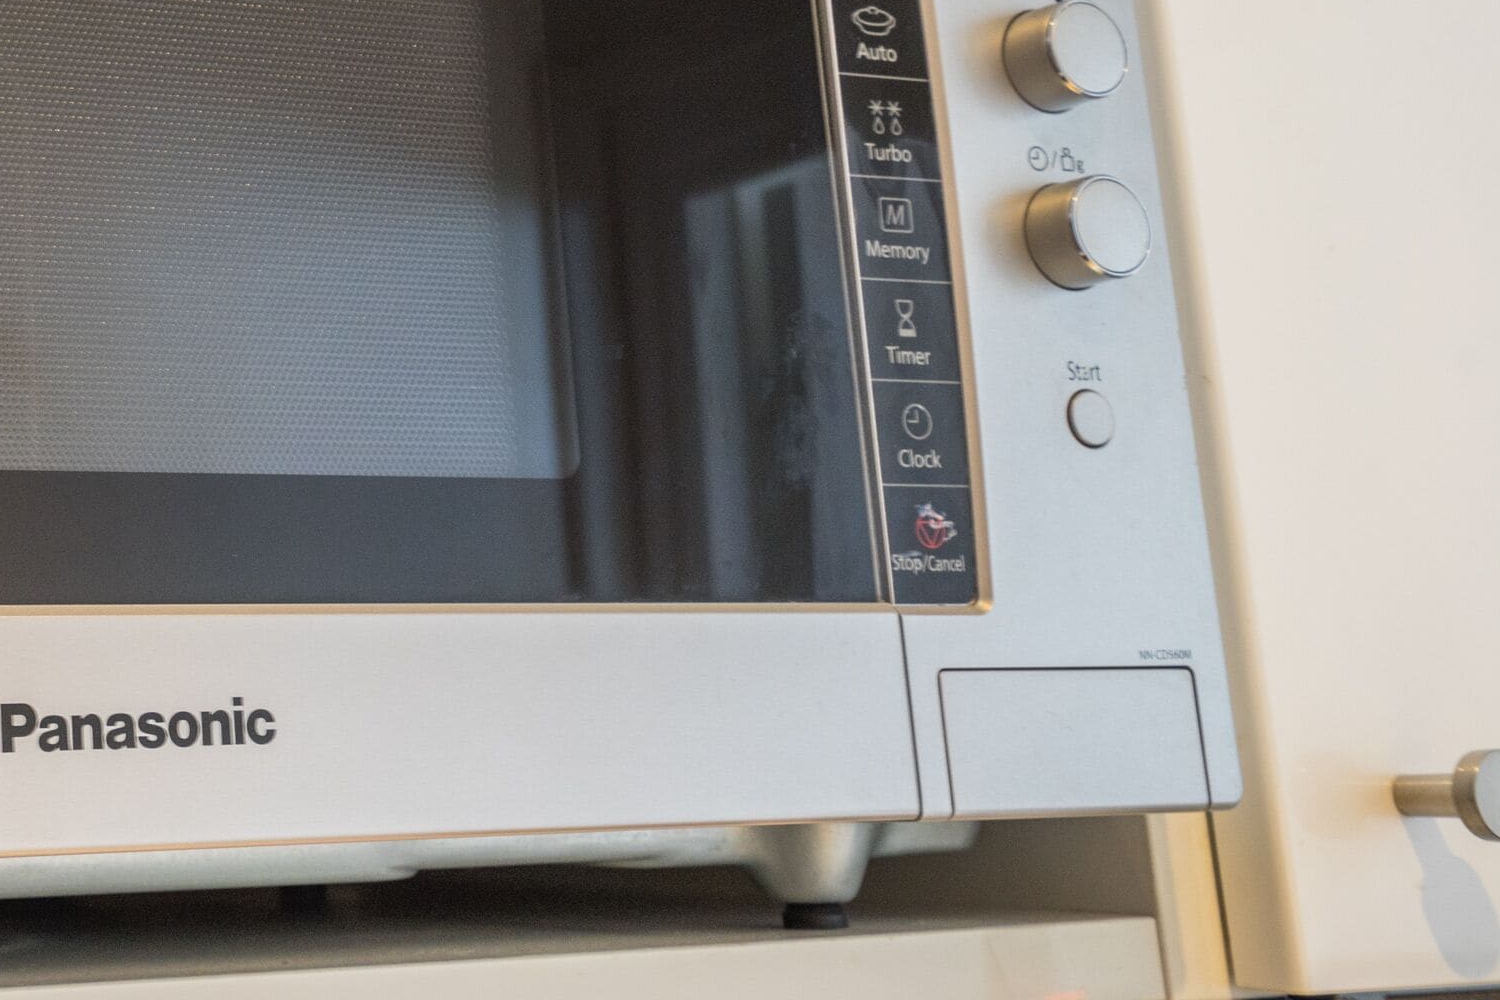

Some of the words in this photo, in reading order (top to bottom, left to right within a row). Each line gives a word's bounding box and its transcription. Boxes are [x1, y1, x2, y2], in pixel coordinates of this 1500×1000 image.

[856, 41, 898, 63] Auto
[864, 142, 912, 163] Turbo
[865, 241, 930, 264] Memory
[886, 346, 931, 366] Timer
[1067, 360, 1102, 382] Start
[899, 449, 942, 469] Clock
[892, 554, 966, 574] Stop/Cancel
[0, 697, 277, 753] Panasonic
